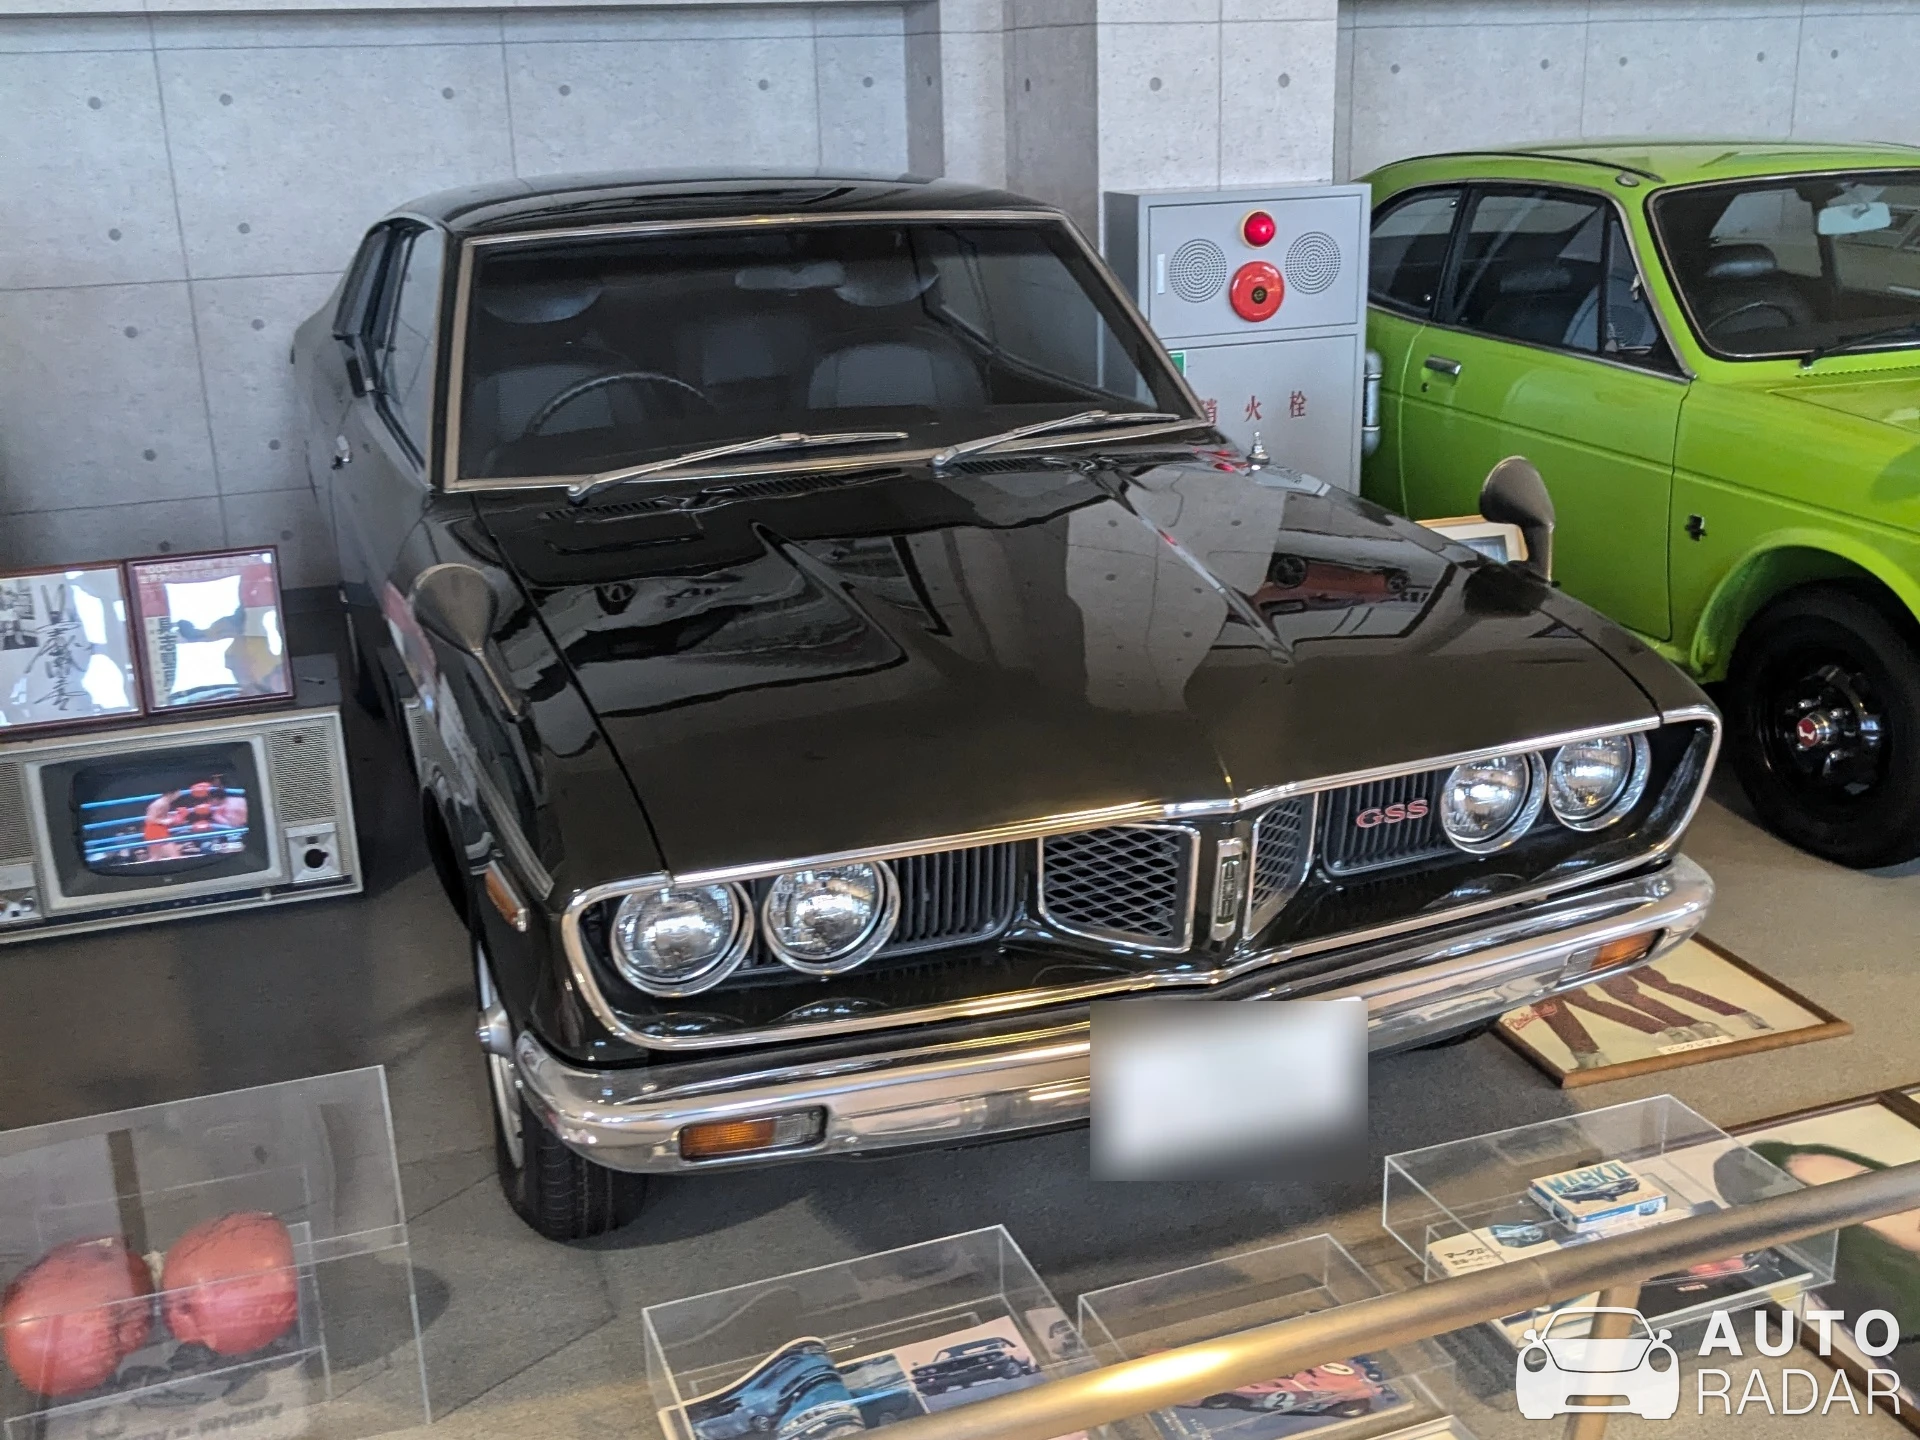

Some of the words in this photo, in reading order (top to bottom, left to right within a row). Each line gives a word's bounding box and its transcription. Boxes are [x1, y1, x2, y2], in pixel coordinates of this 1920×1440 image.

[1356, 799, 1428, 828] GSS
[1543, 1165, 1613, 1195] MARK
[1274, 1393, 1288, 1410] 2
